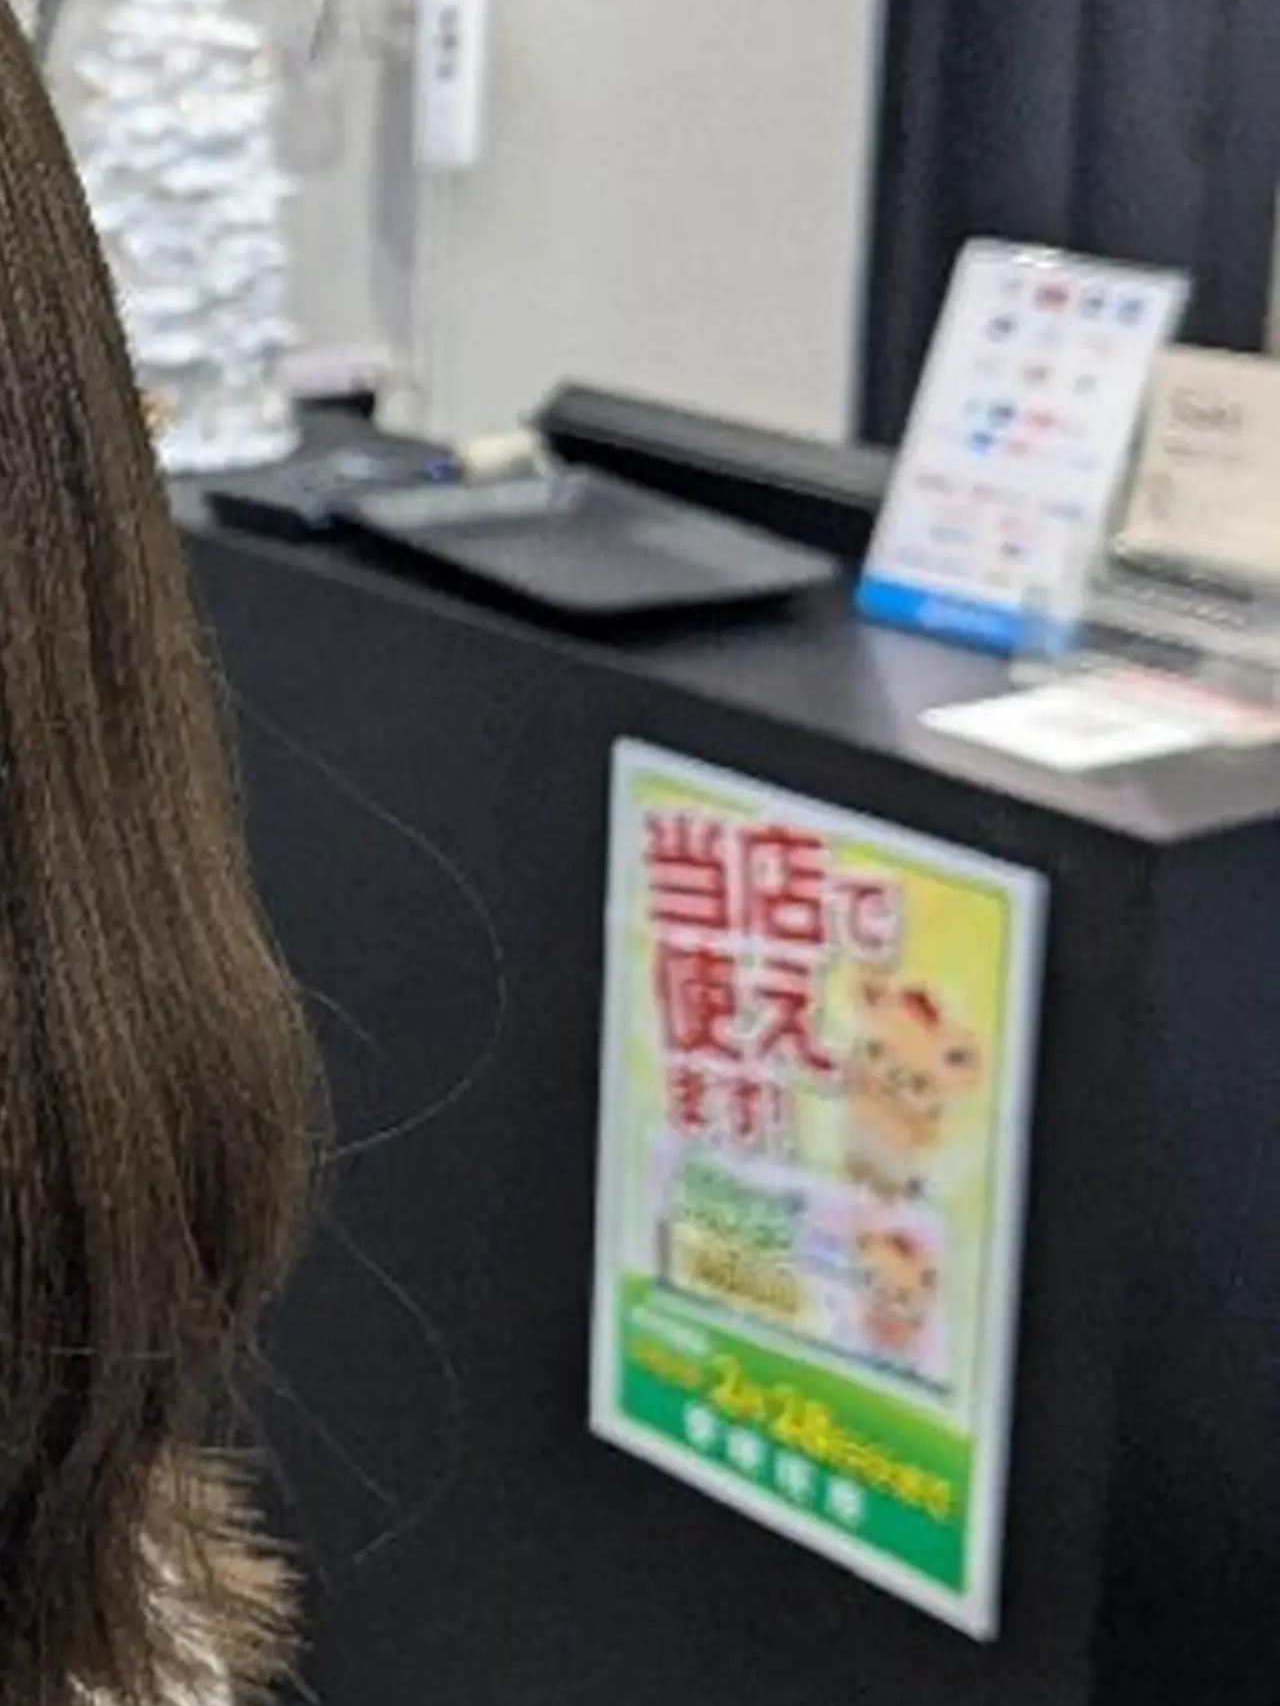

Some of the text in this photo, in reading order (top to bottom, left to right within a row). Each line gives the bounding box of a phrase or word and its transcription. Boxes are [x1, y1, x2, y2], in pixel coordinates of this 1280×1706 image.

[642, 811, 895, 949] 当店で
[654, 939, 834, 1073] 使え
